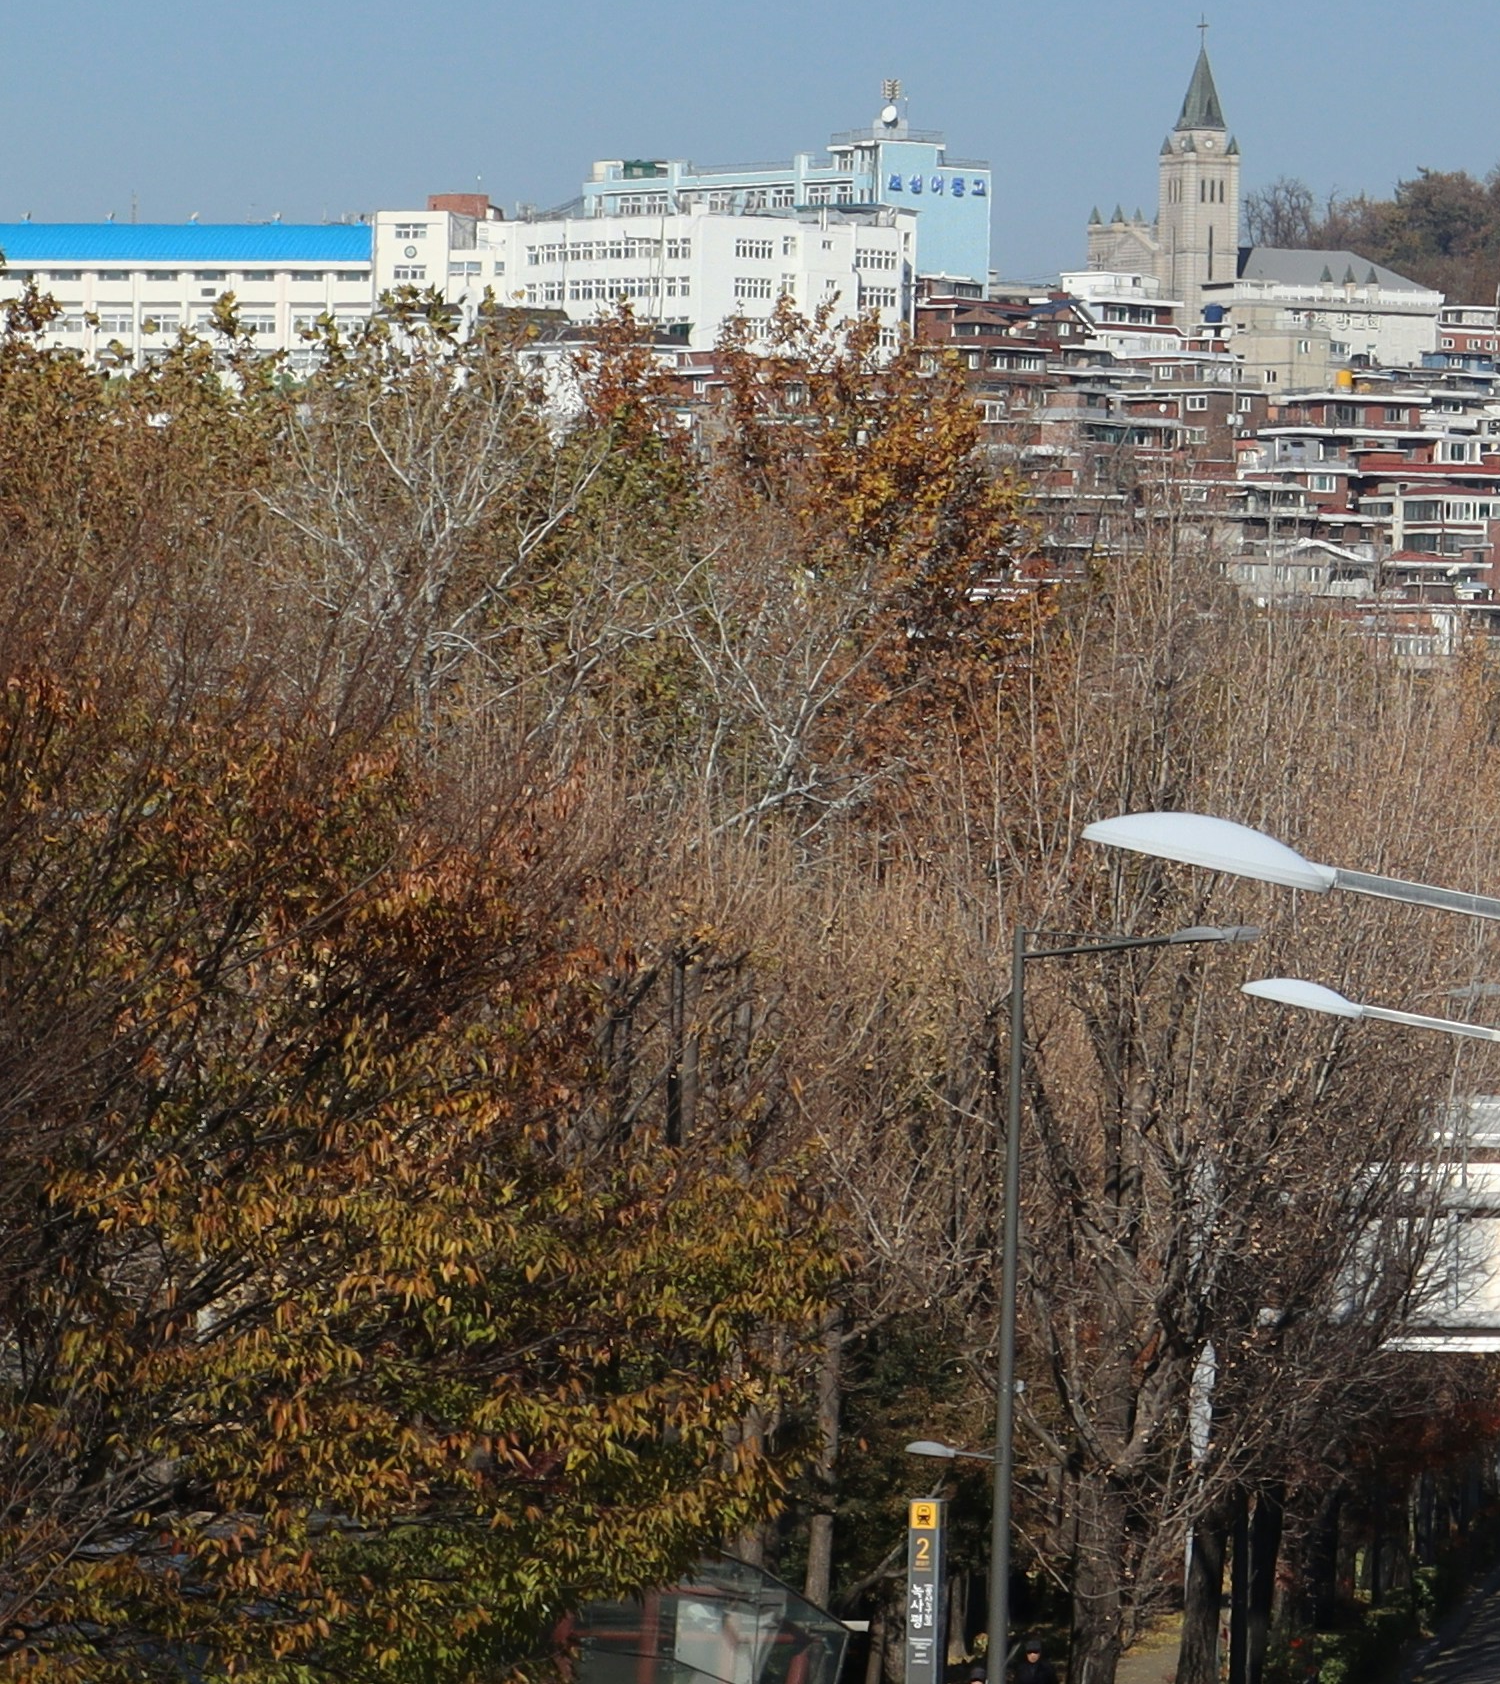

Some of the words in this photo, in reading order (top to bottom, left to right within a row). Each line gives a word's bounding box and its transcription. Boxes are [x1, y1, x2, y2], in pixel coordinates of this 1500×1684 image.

[887, 173, 987, 197] 보성여중고
[916, 1537, 930, 1559] 2
[910, 1583, 924, 1629] 녹사평
